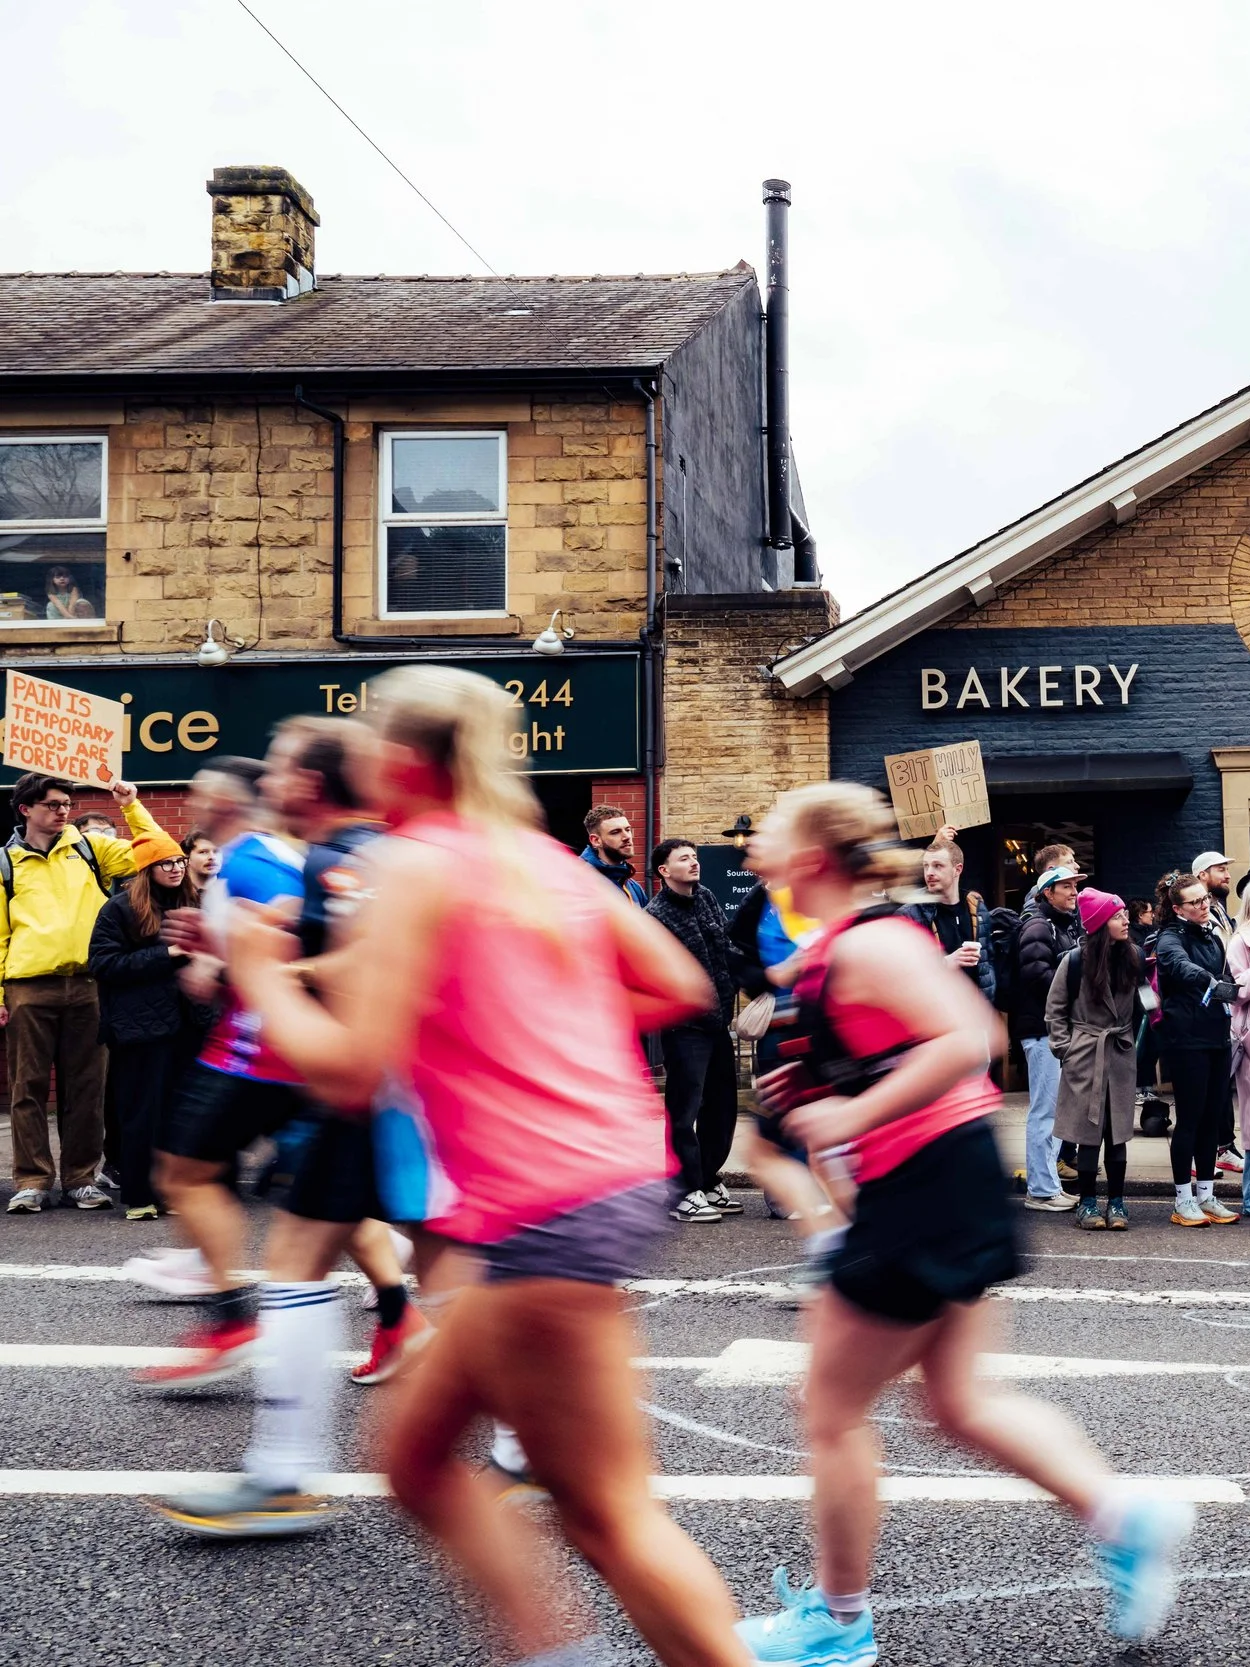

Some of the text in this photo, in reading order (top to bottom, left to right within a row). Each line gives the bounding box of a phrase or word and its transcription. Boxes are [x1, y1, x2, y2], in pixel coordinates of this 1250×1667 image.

[13, 676, 92, 718] PAIN IS
[504, 679, 574, 708] 244
[921, 663, 1139, 709] BAKERY
[10, 723, 109, 763] KUDOS ARE
[121, 692, 220, 753] ice
[508, 721, 566, 760] ght
[9, 741, 89, 780] FOREVER
[890, 745, 979, 787] BIT HILLY
